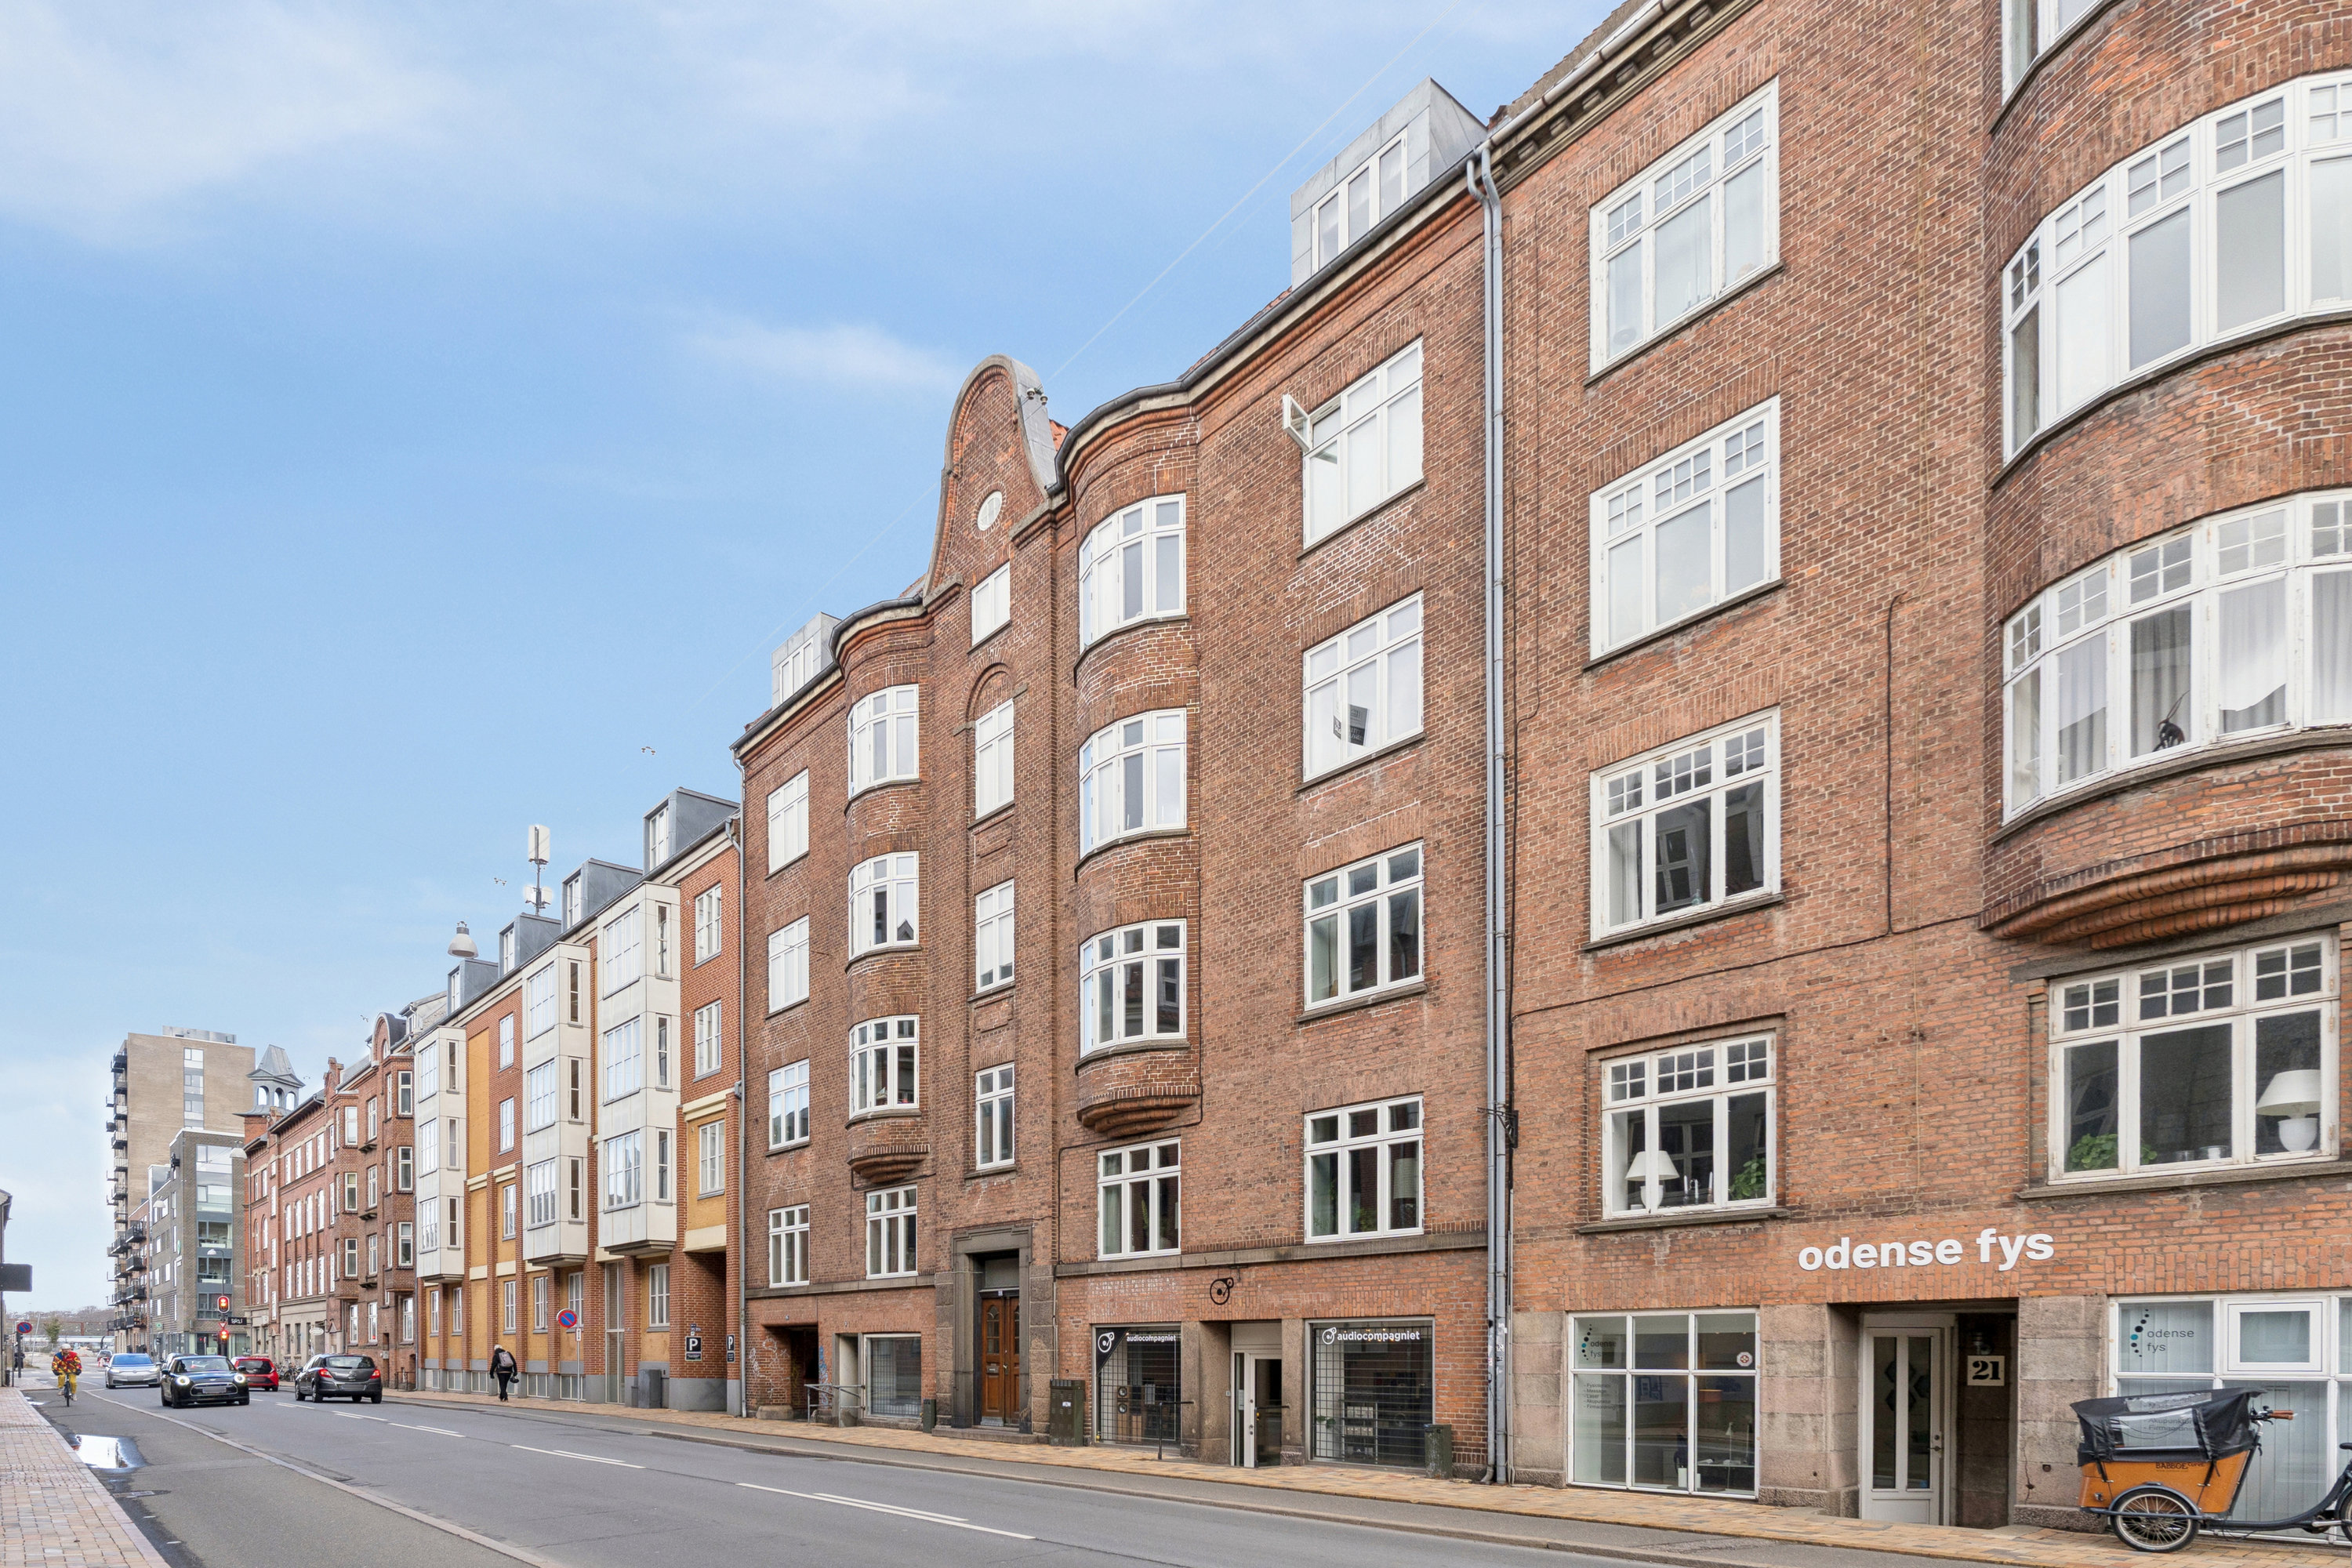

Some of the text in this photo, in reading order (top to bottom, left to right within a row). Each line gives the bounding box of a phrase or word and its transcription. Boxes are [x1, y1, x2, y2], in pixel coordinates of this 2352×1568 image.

[1798, 1228, 2055, 1272] odense fys
[1337, 1330, 1421, 1342] audiocompagniet
[2147, 1329, 2194, 1338] odense
[689, 1338, 699, 1351] P
[728, 1336, 734, 1349] P
[2147, 1342, 2166, 1354] fys
[1590, 1349, 1602, 1359] fys
[1972, 1360, 2002, 1380] 21
